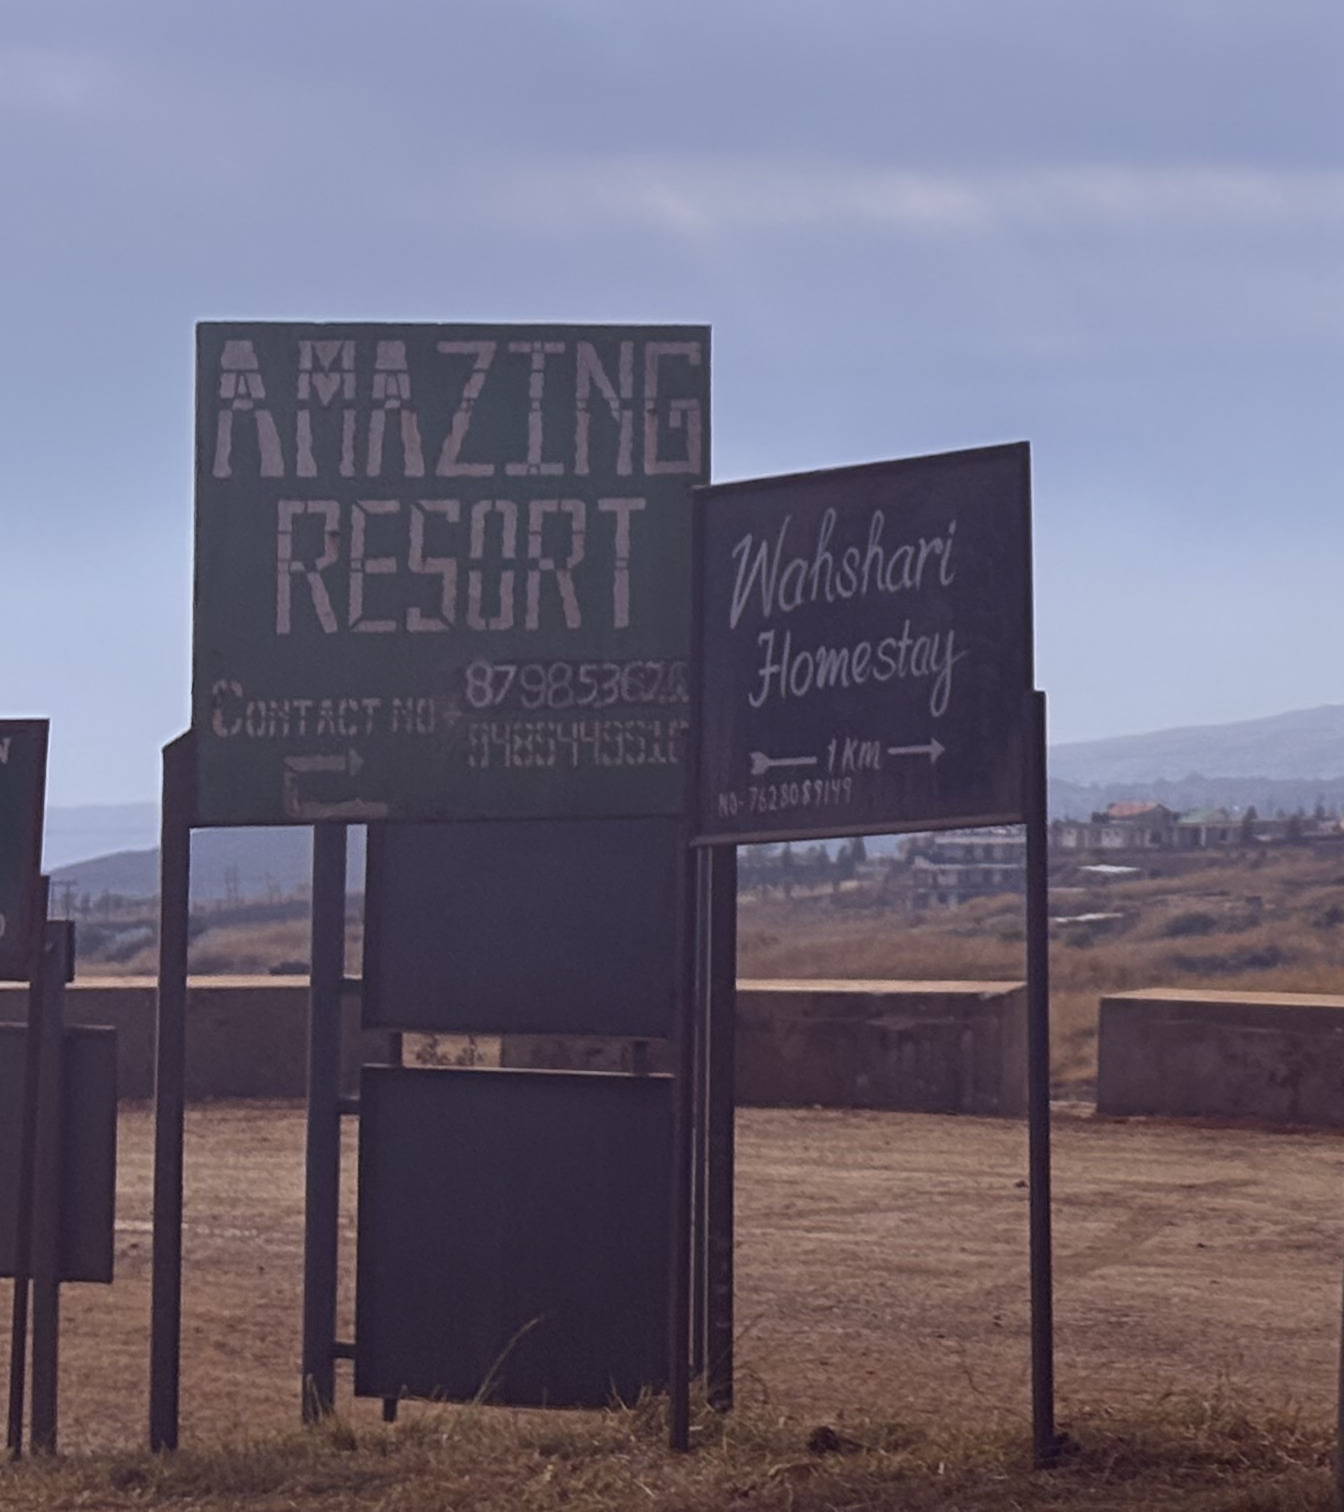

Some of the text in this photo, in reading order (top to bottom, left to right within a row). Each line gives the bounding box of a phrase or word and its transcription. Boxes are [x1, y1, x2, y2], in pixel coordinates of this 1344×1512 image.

[212, 339, 702, 478] AMAZING
[275, 498, 647, 635] RESORT
[729, 507, 957, 630] Wahshari
[748, 619, 970, 718] Homestay
